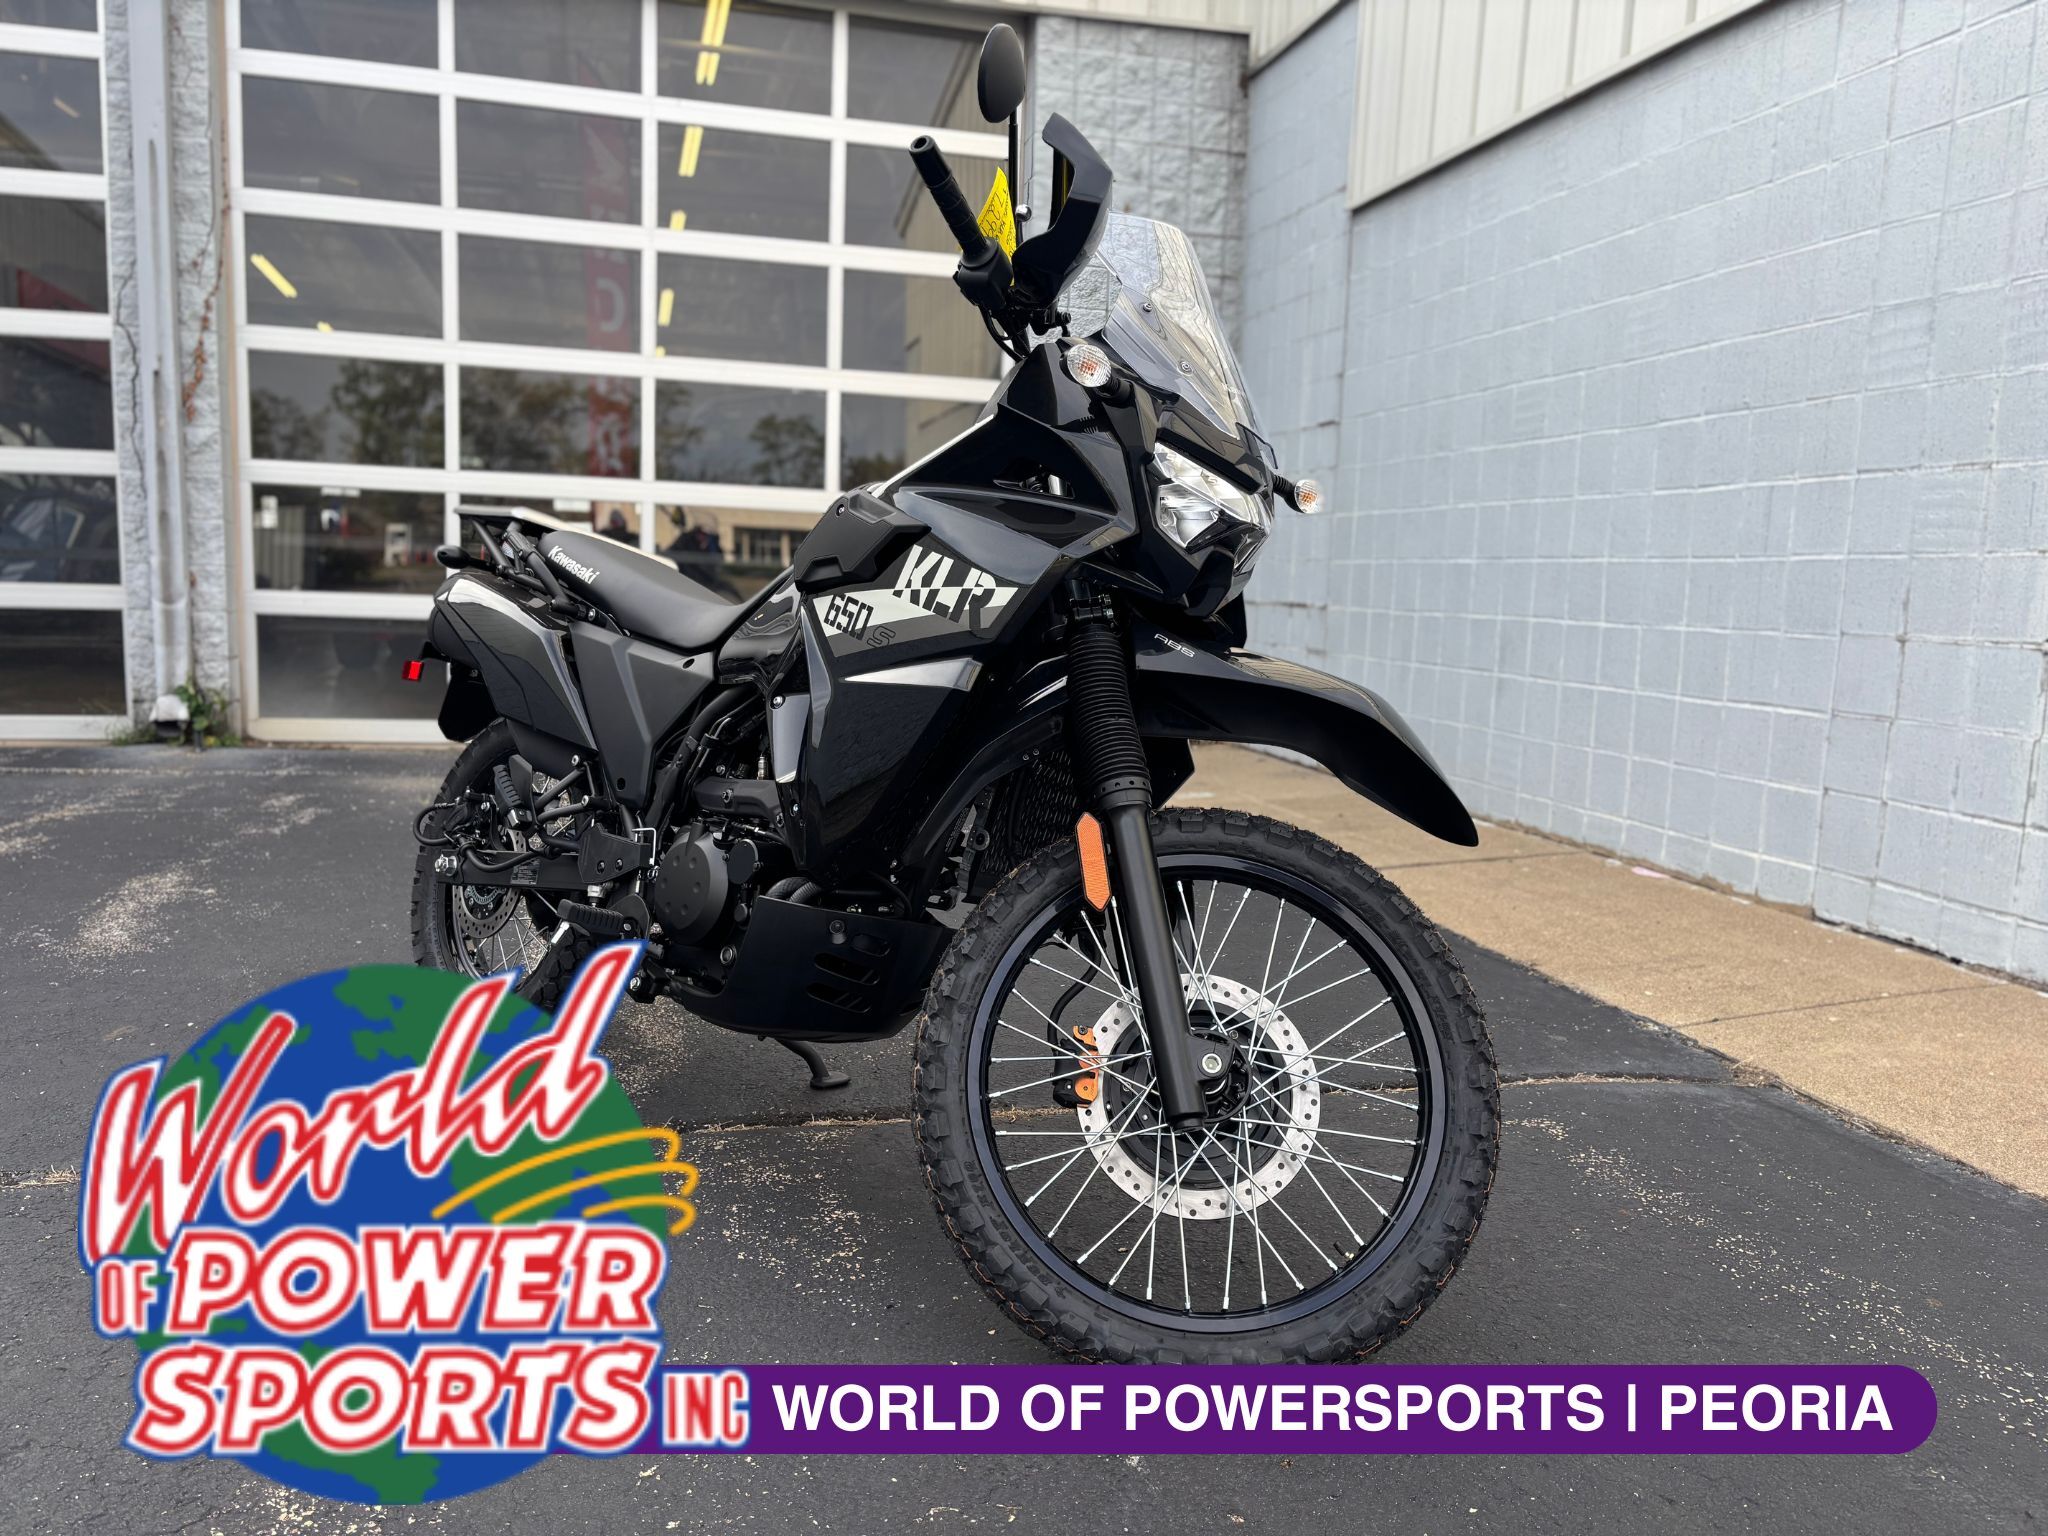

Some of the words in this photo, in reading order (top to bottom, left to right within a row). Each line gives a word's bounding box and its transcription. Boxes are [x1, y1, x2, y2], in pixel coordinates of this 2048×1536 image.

[547, 545, 600, 585] Kawasaki
[892, 544, 997, 630] KLR
[823, 593, 874, 641] 650
[866, 625, 897, 647] S
[1154, 633, 1196, 658] ABS
